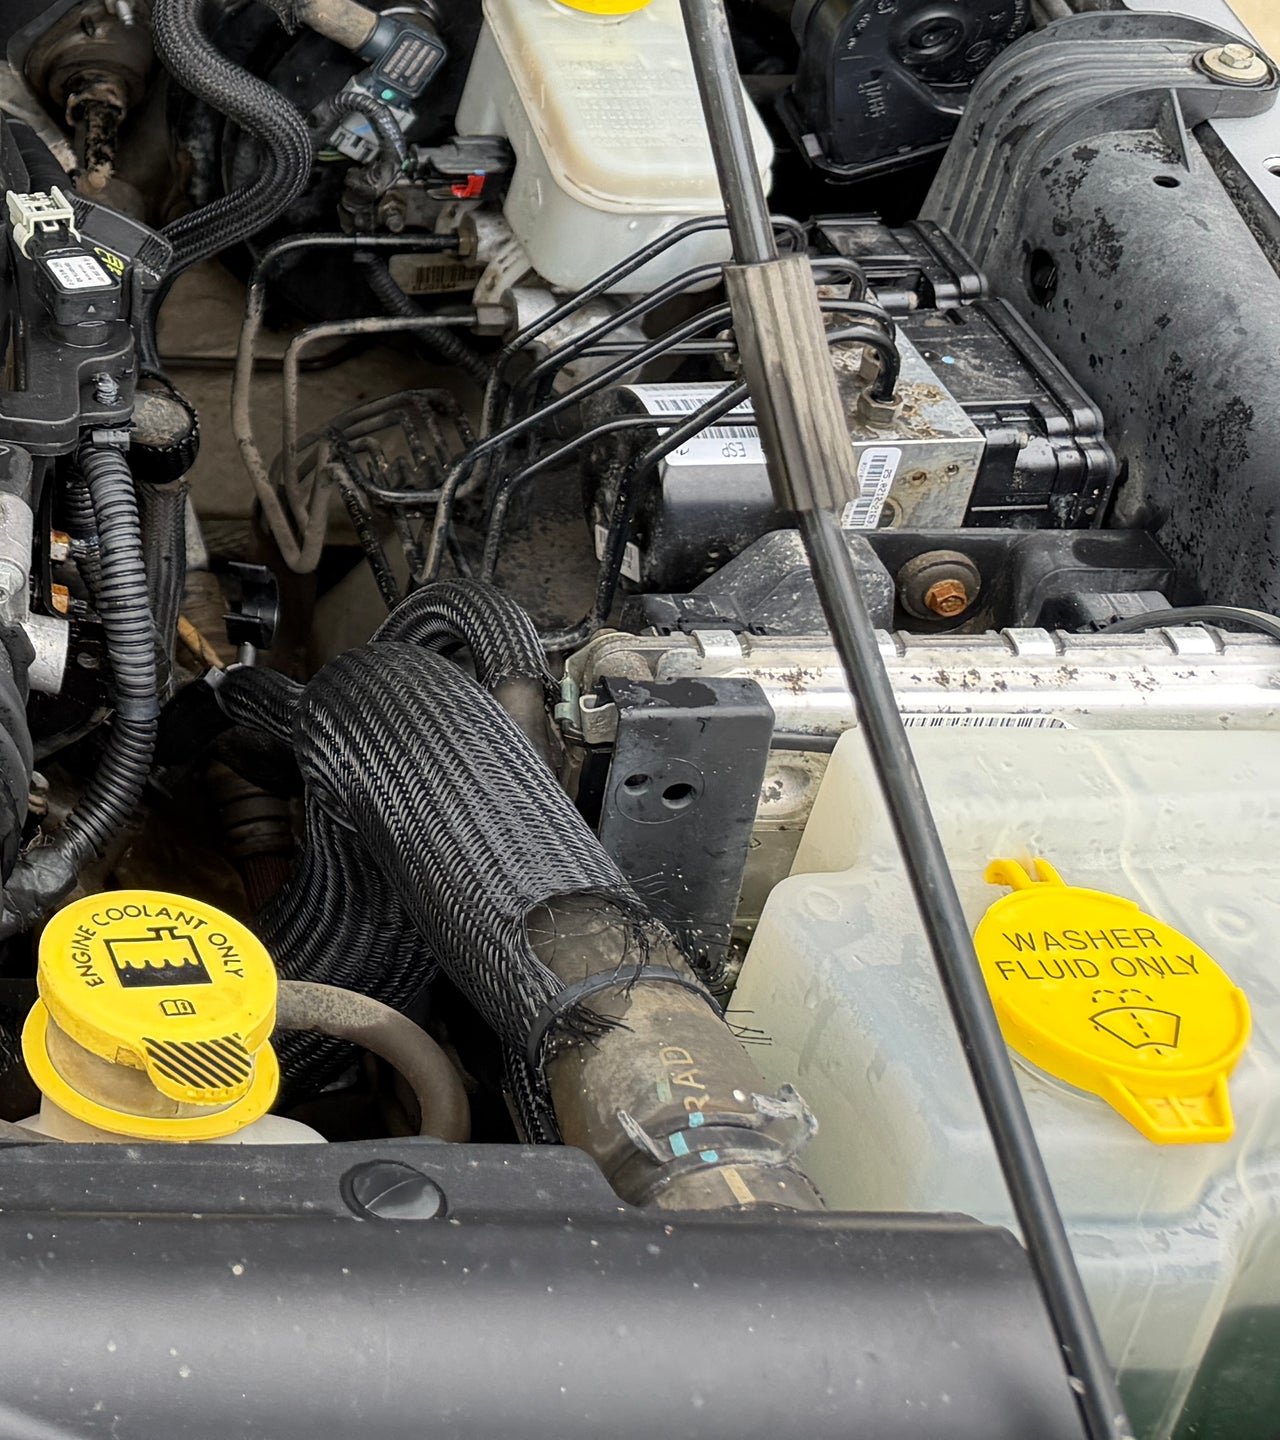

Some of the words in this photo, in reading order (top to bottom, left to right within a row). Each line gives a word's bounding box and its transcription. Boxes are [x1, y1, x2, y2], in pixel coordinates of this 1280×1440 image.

[722, 442, 747, 458] ESP
[72, 925, 105, 989] ENGINE
[91, 904, 209, 930] COOLANT
[208, 932, 246, 979] ONLY
[1002, 927, 1162, 952] WASHER
[995, 958, 1100, 981] FLUID
[1110, 954, 1200, 979] ONLY
